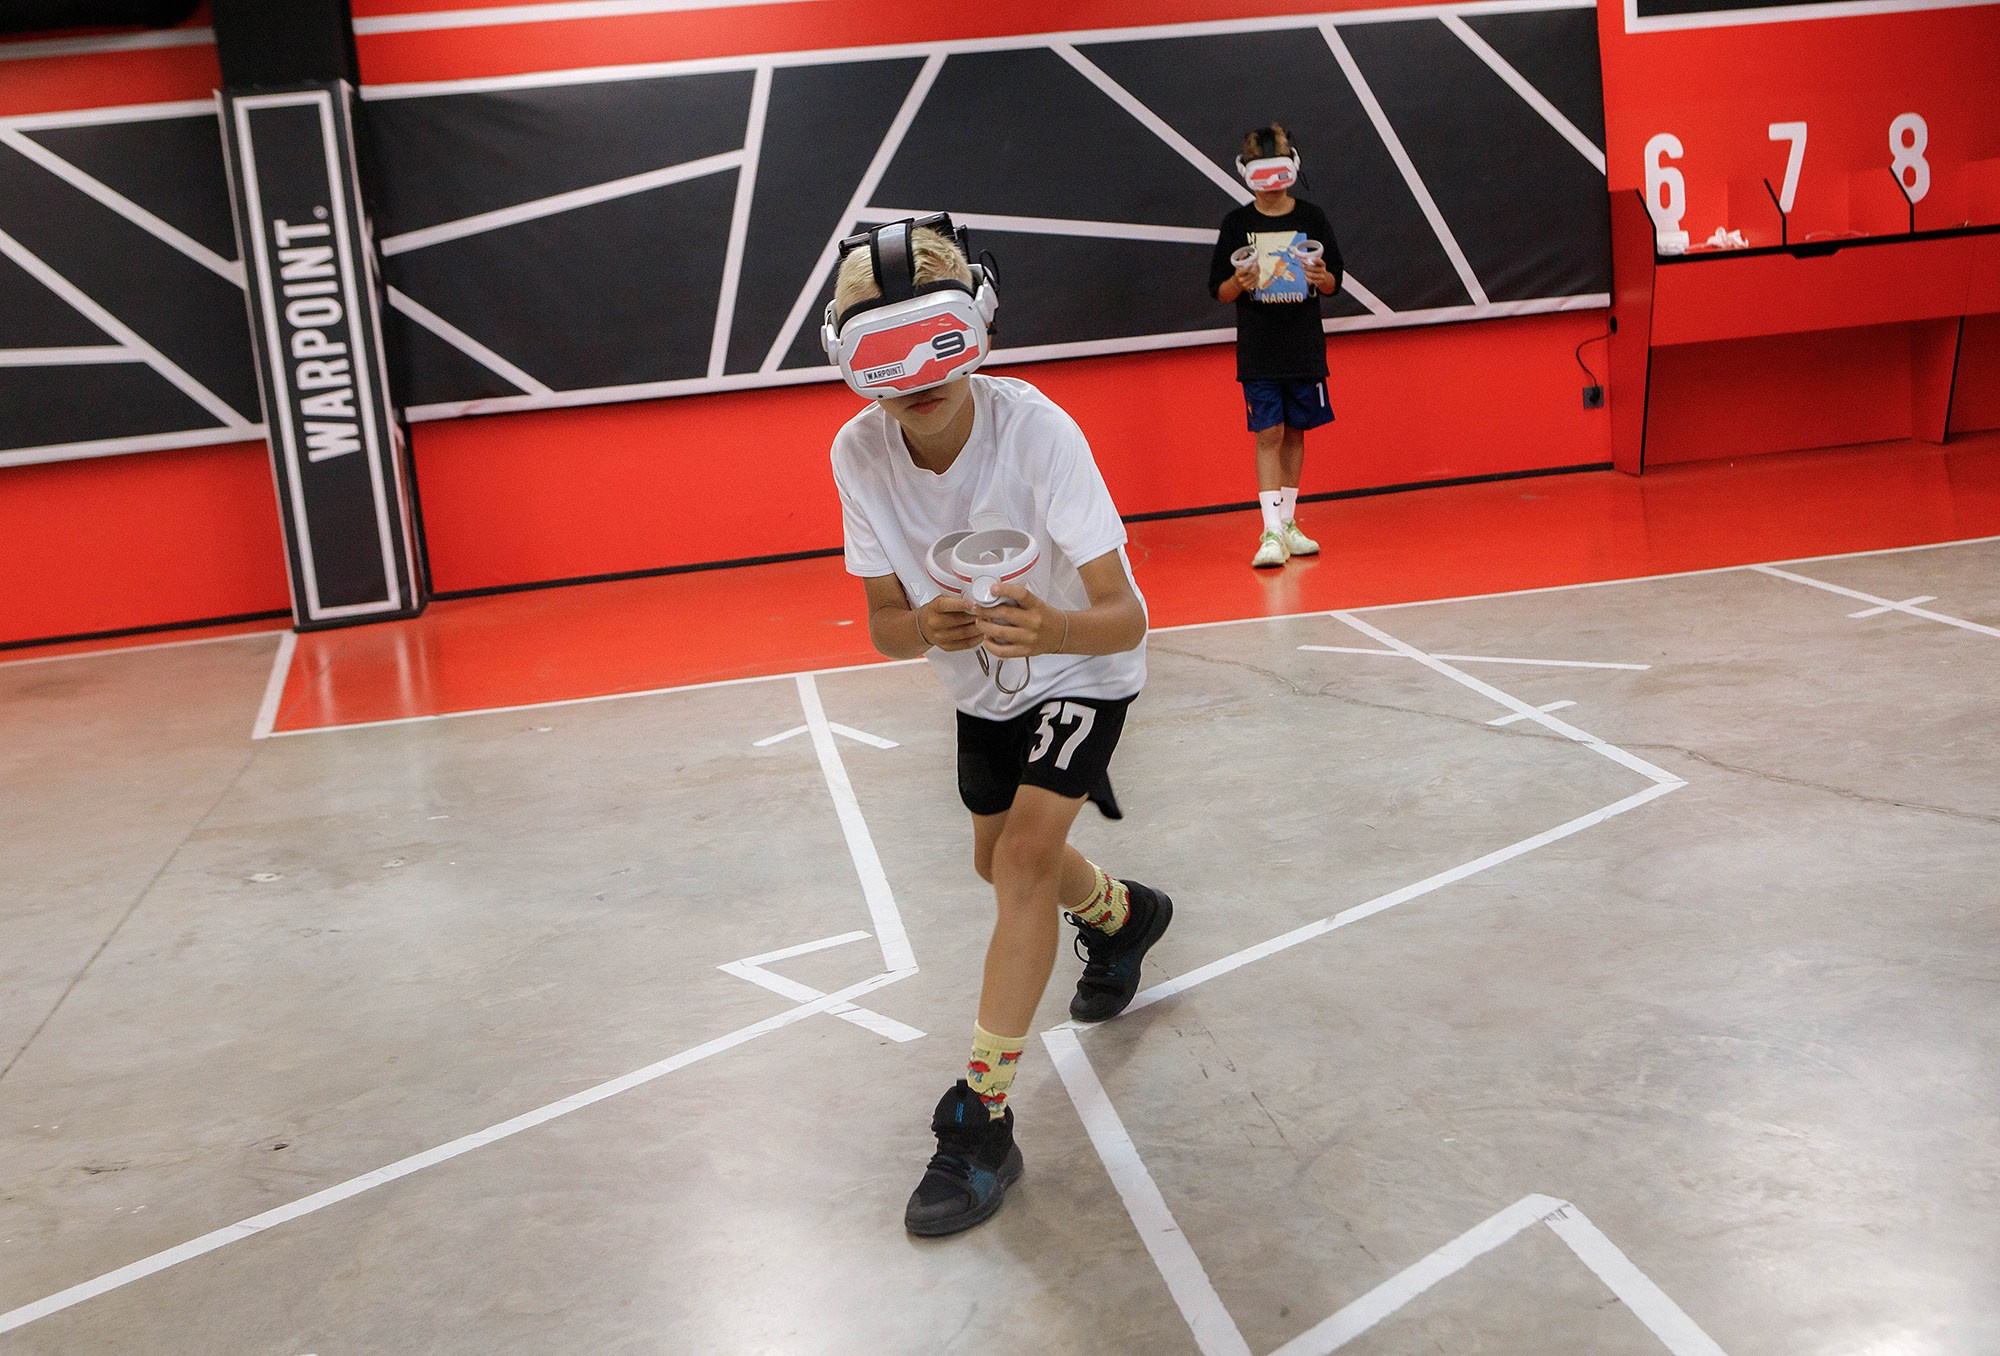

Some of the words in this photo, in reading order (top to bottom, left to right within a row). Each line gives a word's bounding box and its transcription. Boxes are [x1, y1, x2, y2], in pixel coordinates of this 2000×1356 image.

[1644, 132, 1686, 225] 6
[1768, 121, 1808, 213] 7
[1888, 112, 1931, 204] 8
[1261, 291, 1304, 304] NARUTO
[932, 331, 966, 359] 9
[866, 365, 902, 380] WARPOINT
[1315, 382, 1325, 408] 1
[1028, 700, 1097, 771] 37
